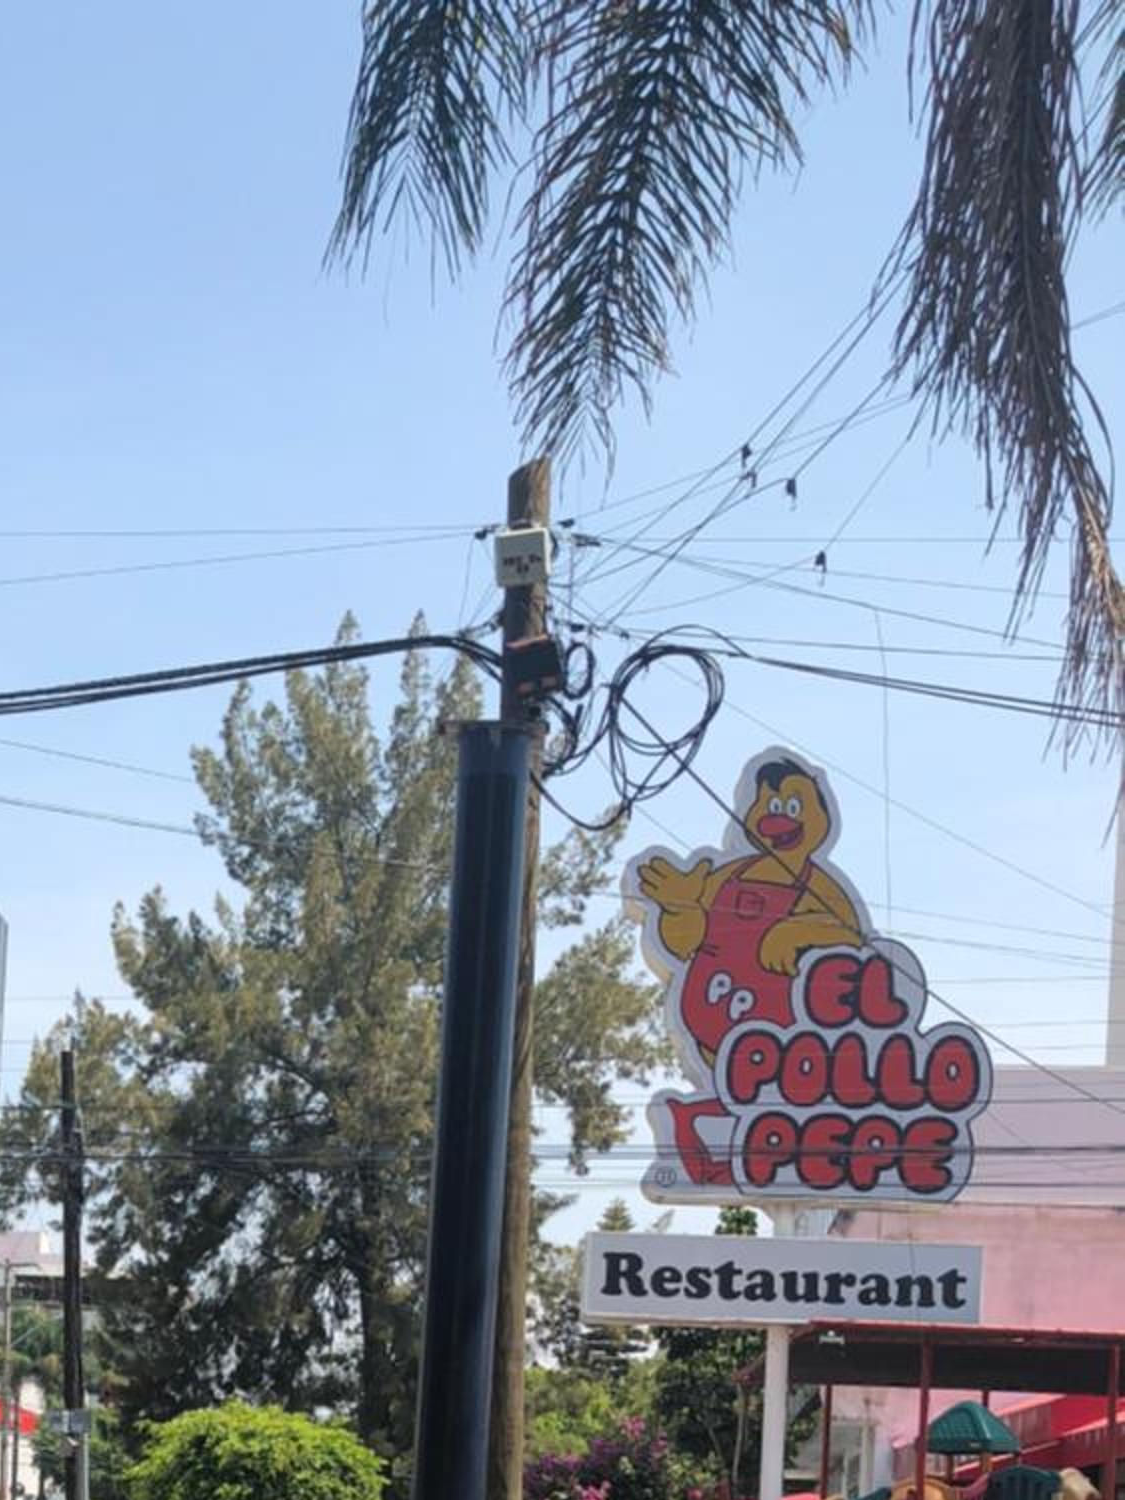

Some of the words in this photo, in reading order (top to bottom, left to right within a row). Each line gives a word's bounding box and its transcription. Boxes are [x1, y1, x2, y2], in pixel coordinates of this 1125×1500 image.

[806, 955, 907, 1028] EL
[728, 1031, 980, 1110] POLLO
[744, 1114, 958, 1192] PEPE
[602, 1252, 968, 1308] Restaurant
